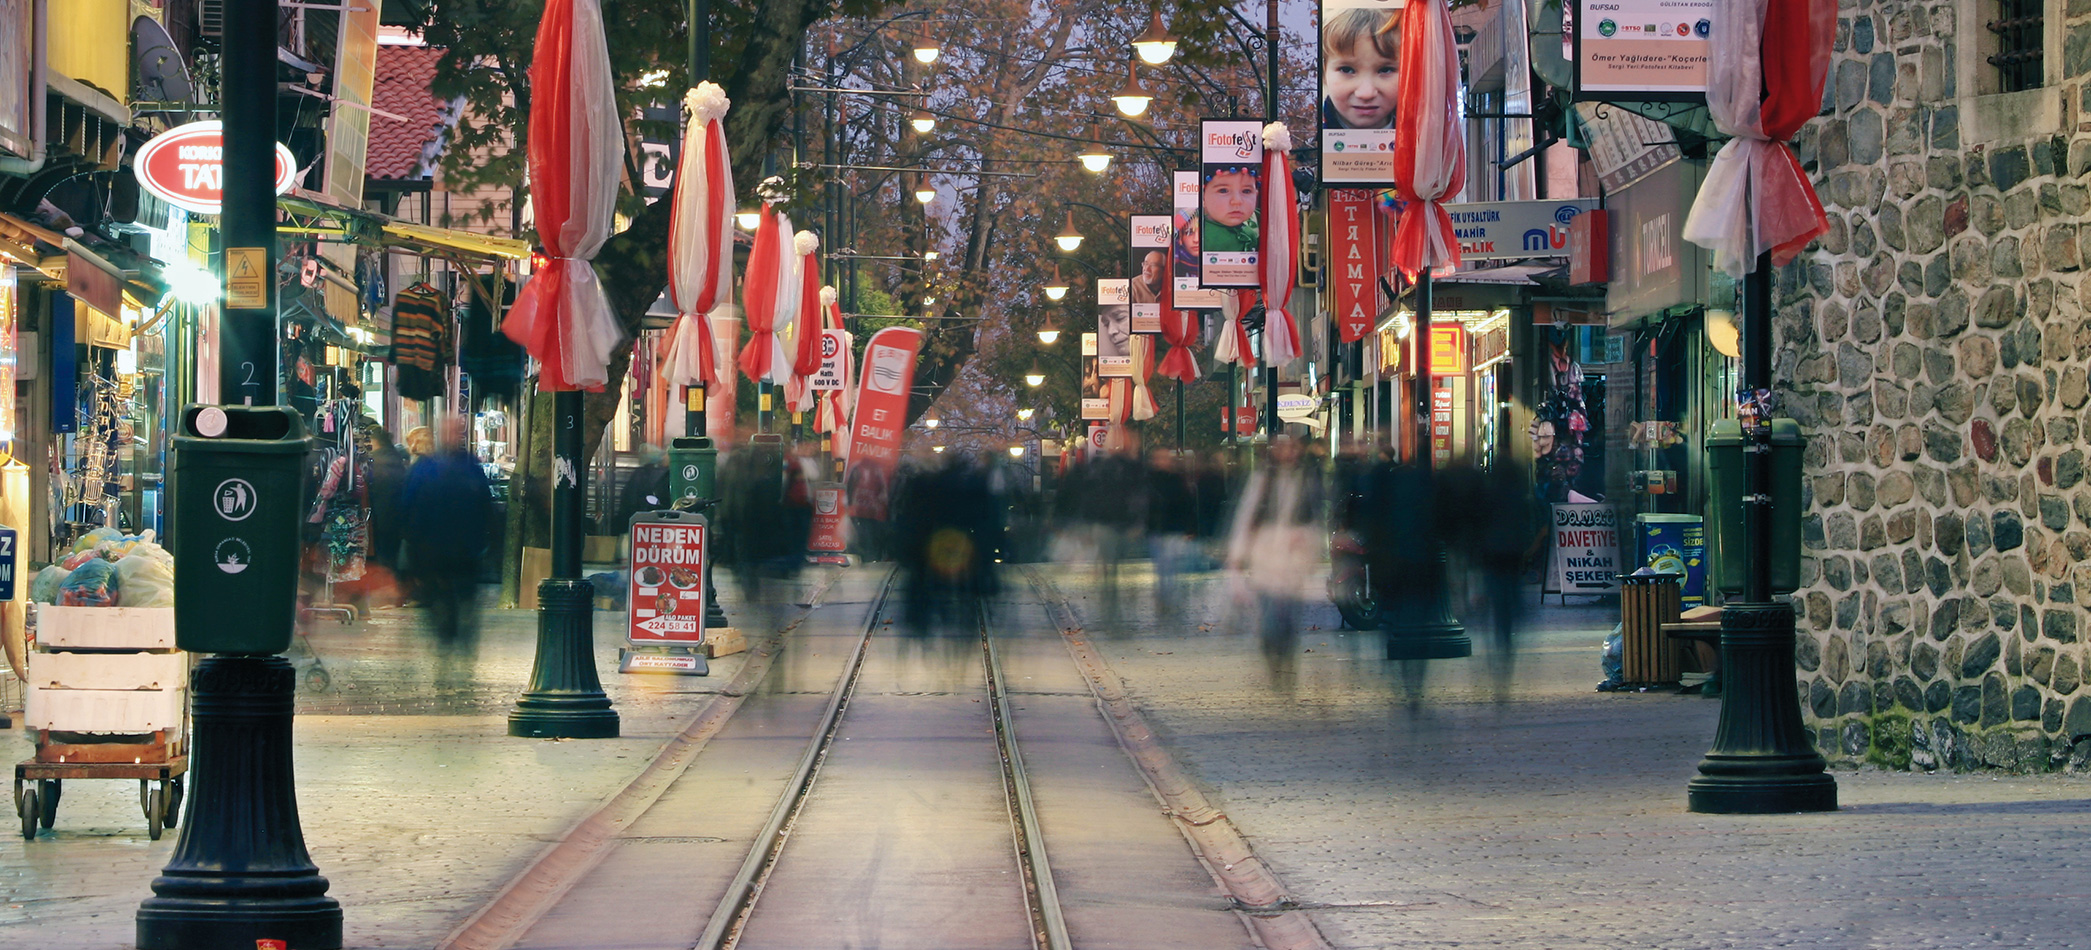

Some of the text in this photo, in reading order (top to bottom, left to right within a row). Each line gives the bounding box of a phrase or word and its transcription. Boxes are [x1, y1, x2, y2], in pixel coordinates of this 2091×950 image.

[1592, 52, 1616, 61] Ömer
[1462, 209, 1501, 223] UYSALTÜRK
[241, 361, 260, 386] 2
[566, 415, 574, 430] 3
[860, 424, 894, 442] BALIK
[1556, 508, 1615, 528] Damat
[636, 527, 700, 545] NEDEN
[636, 545, 700, 565] DÜRÜM
[648, 621, 694, 631] 224 58 41
